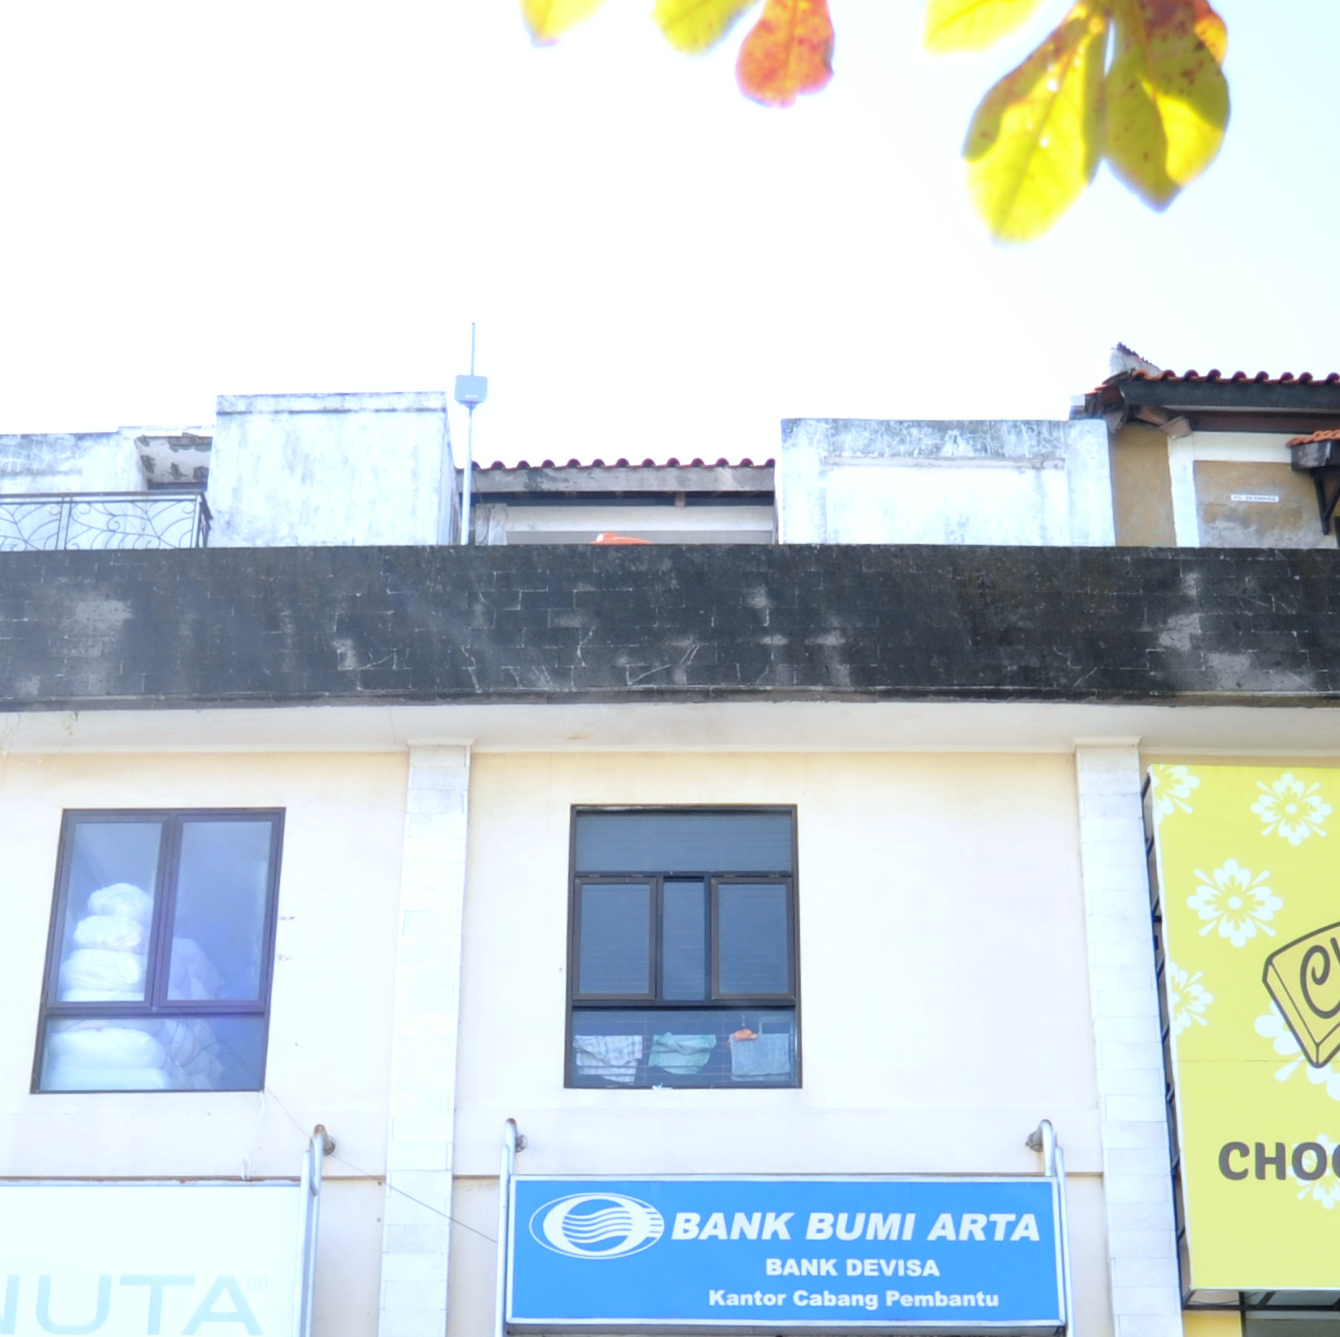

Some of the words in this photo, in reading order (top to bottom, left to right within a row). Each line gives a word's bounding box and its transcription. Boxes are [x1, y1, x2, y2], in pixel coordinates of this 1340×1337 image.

[671, 1211, 796, 1242] BANK
[805, 1211, 914, 1242] BUMI
[926, 1212, 1041, 1242] ARTA
[765, 1258, 838, 1277] BANK
[845, 1258, 941, 1278] DEVISA
[708, 1289, 787, 1308] Kantor
[792, 1289, 878, 1311] Cabang
[884, 1289, 1000, 1308] Pembantu
